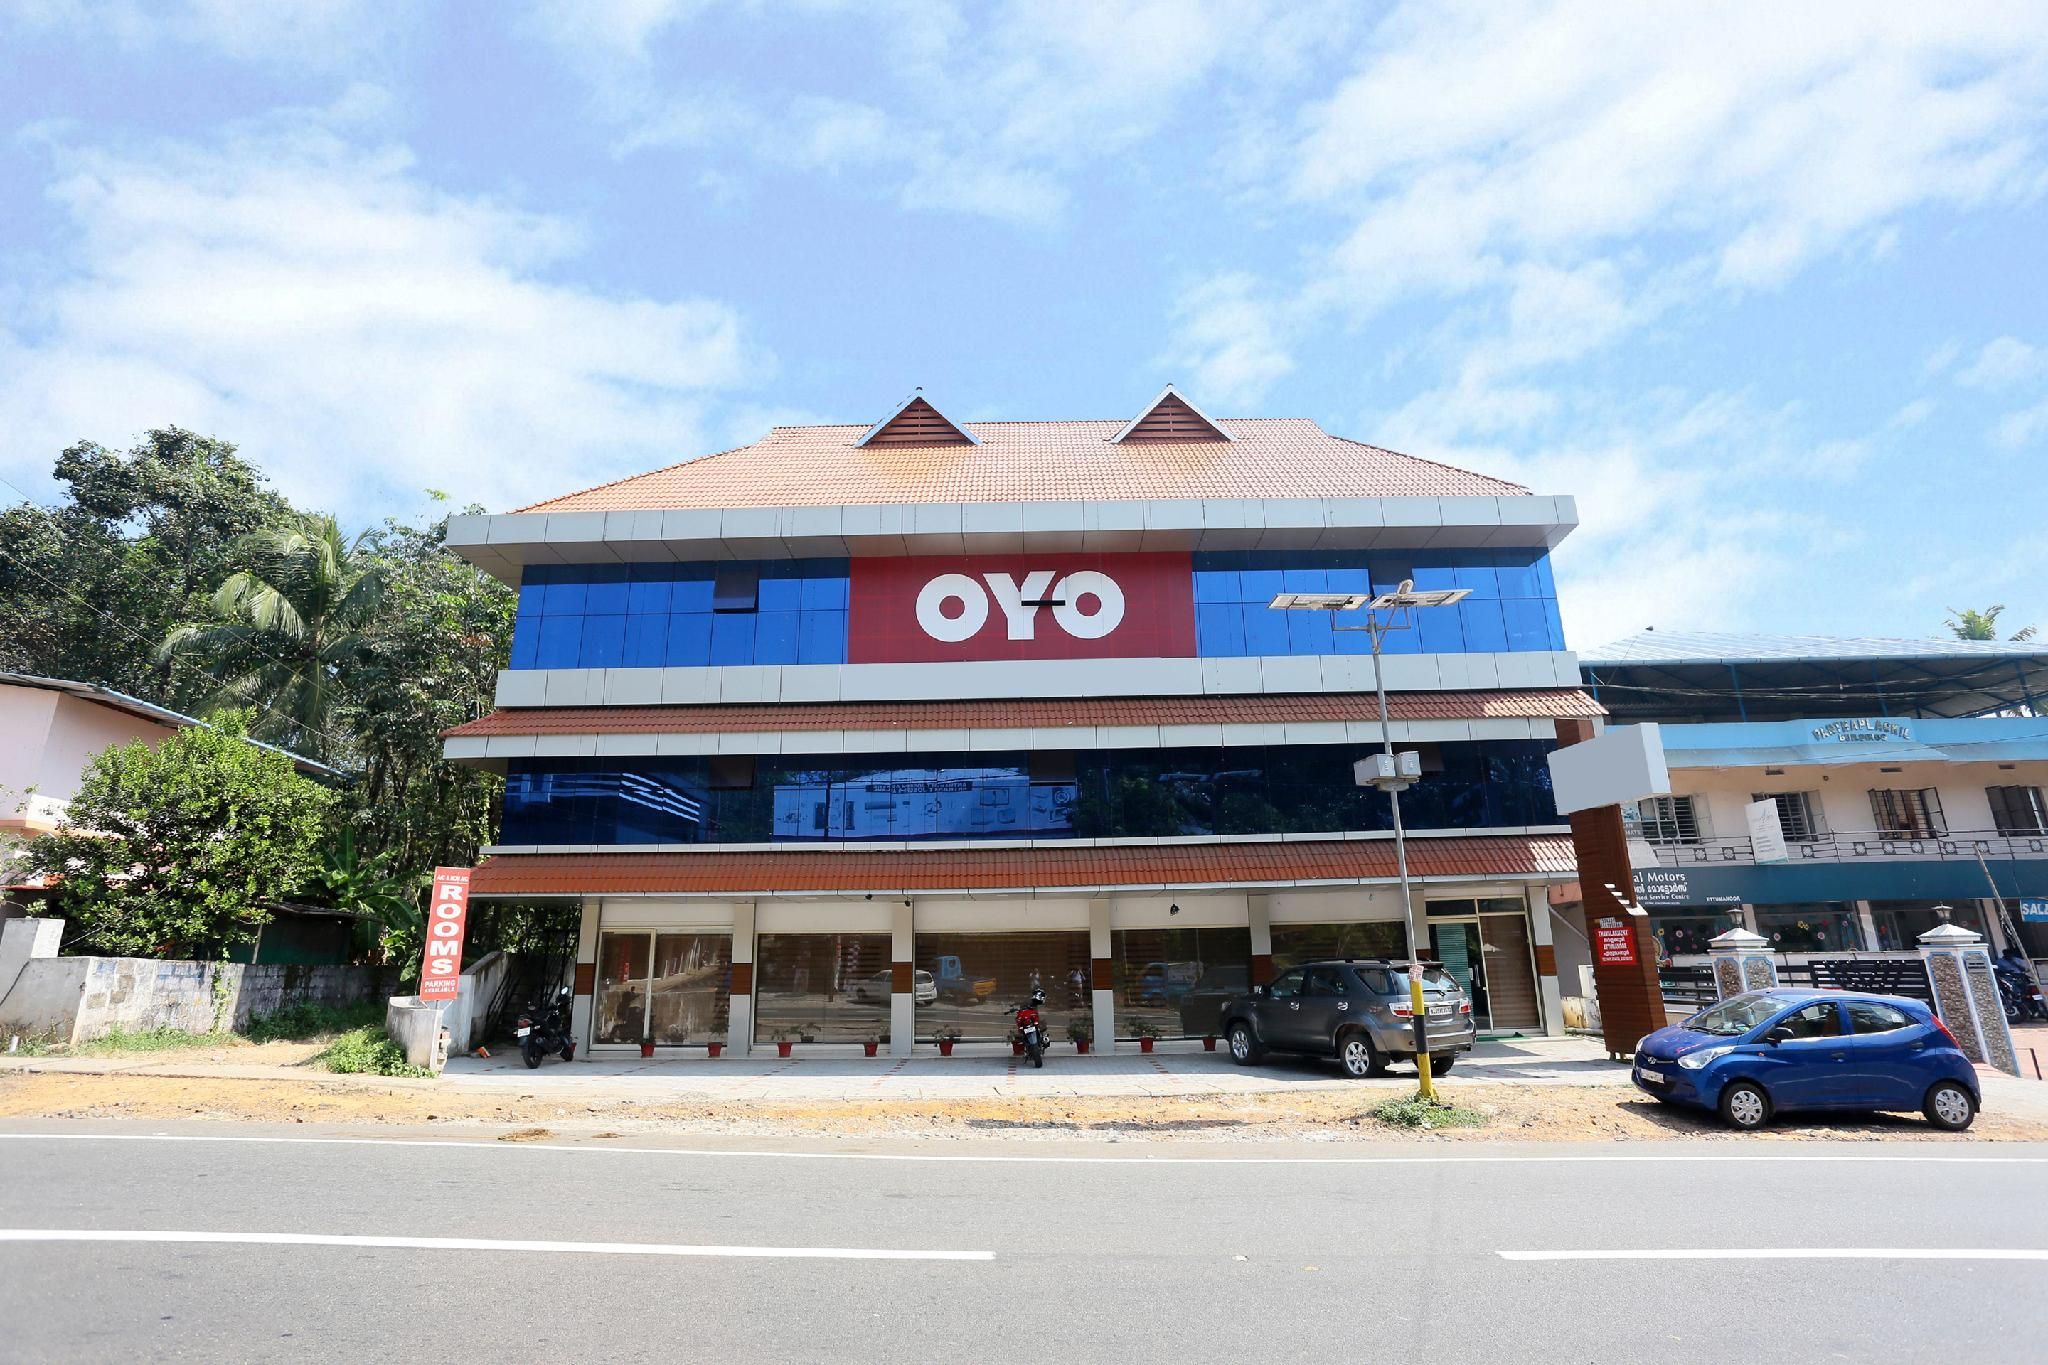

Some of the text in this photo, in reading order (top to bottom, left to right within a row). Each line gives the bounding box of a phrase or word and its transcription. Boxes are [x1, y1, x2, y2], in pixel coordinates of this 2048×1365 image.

[915, 571, 1125, 642] OYO
[1647, 872, 1686, 882] Motors
[429, 884, 463, 975] ROOMS
[424, 980, 456, 988] PARKING
